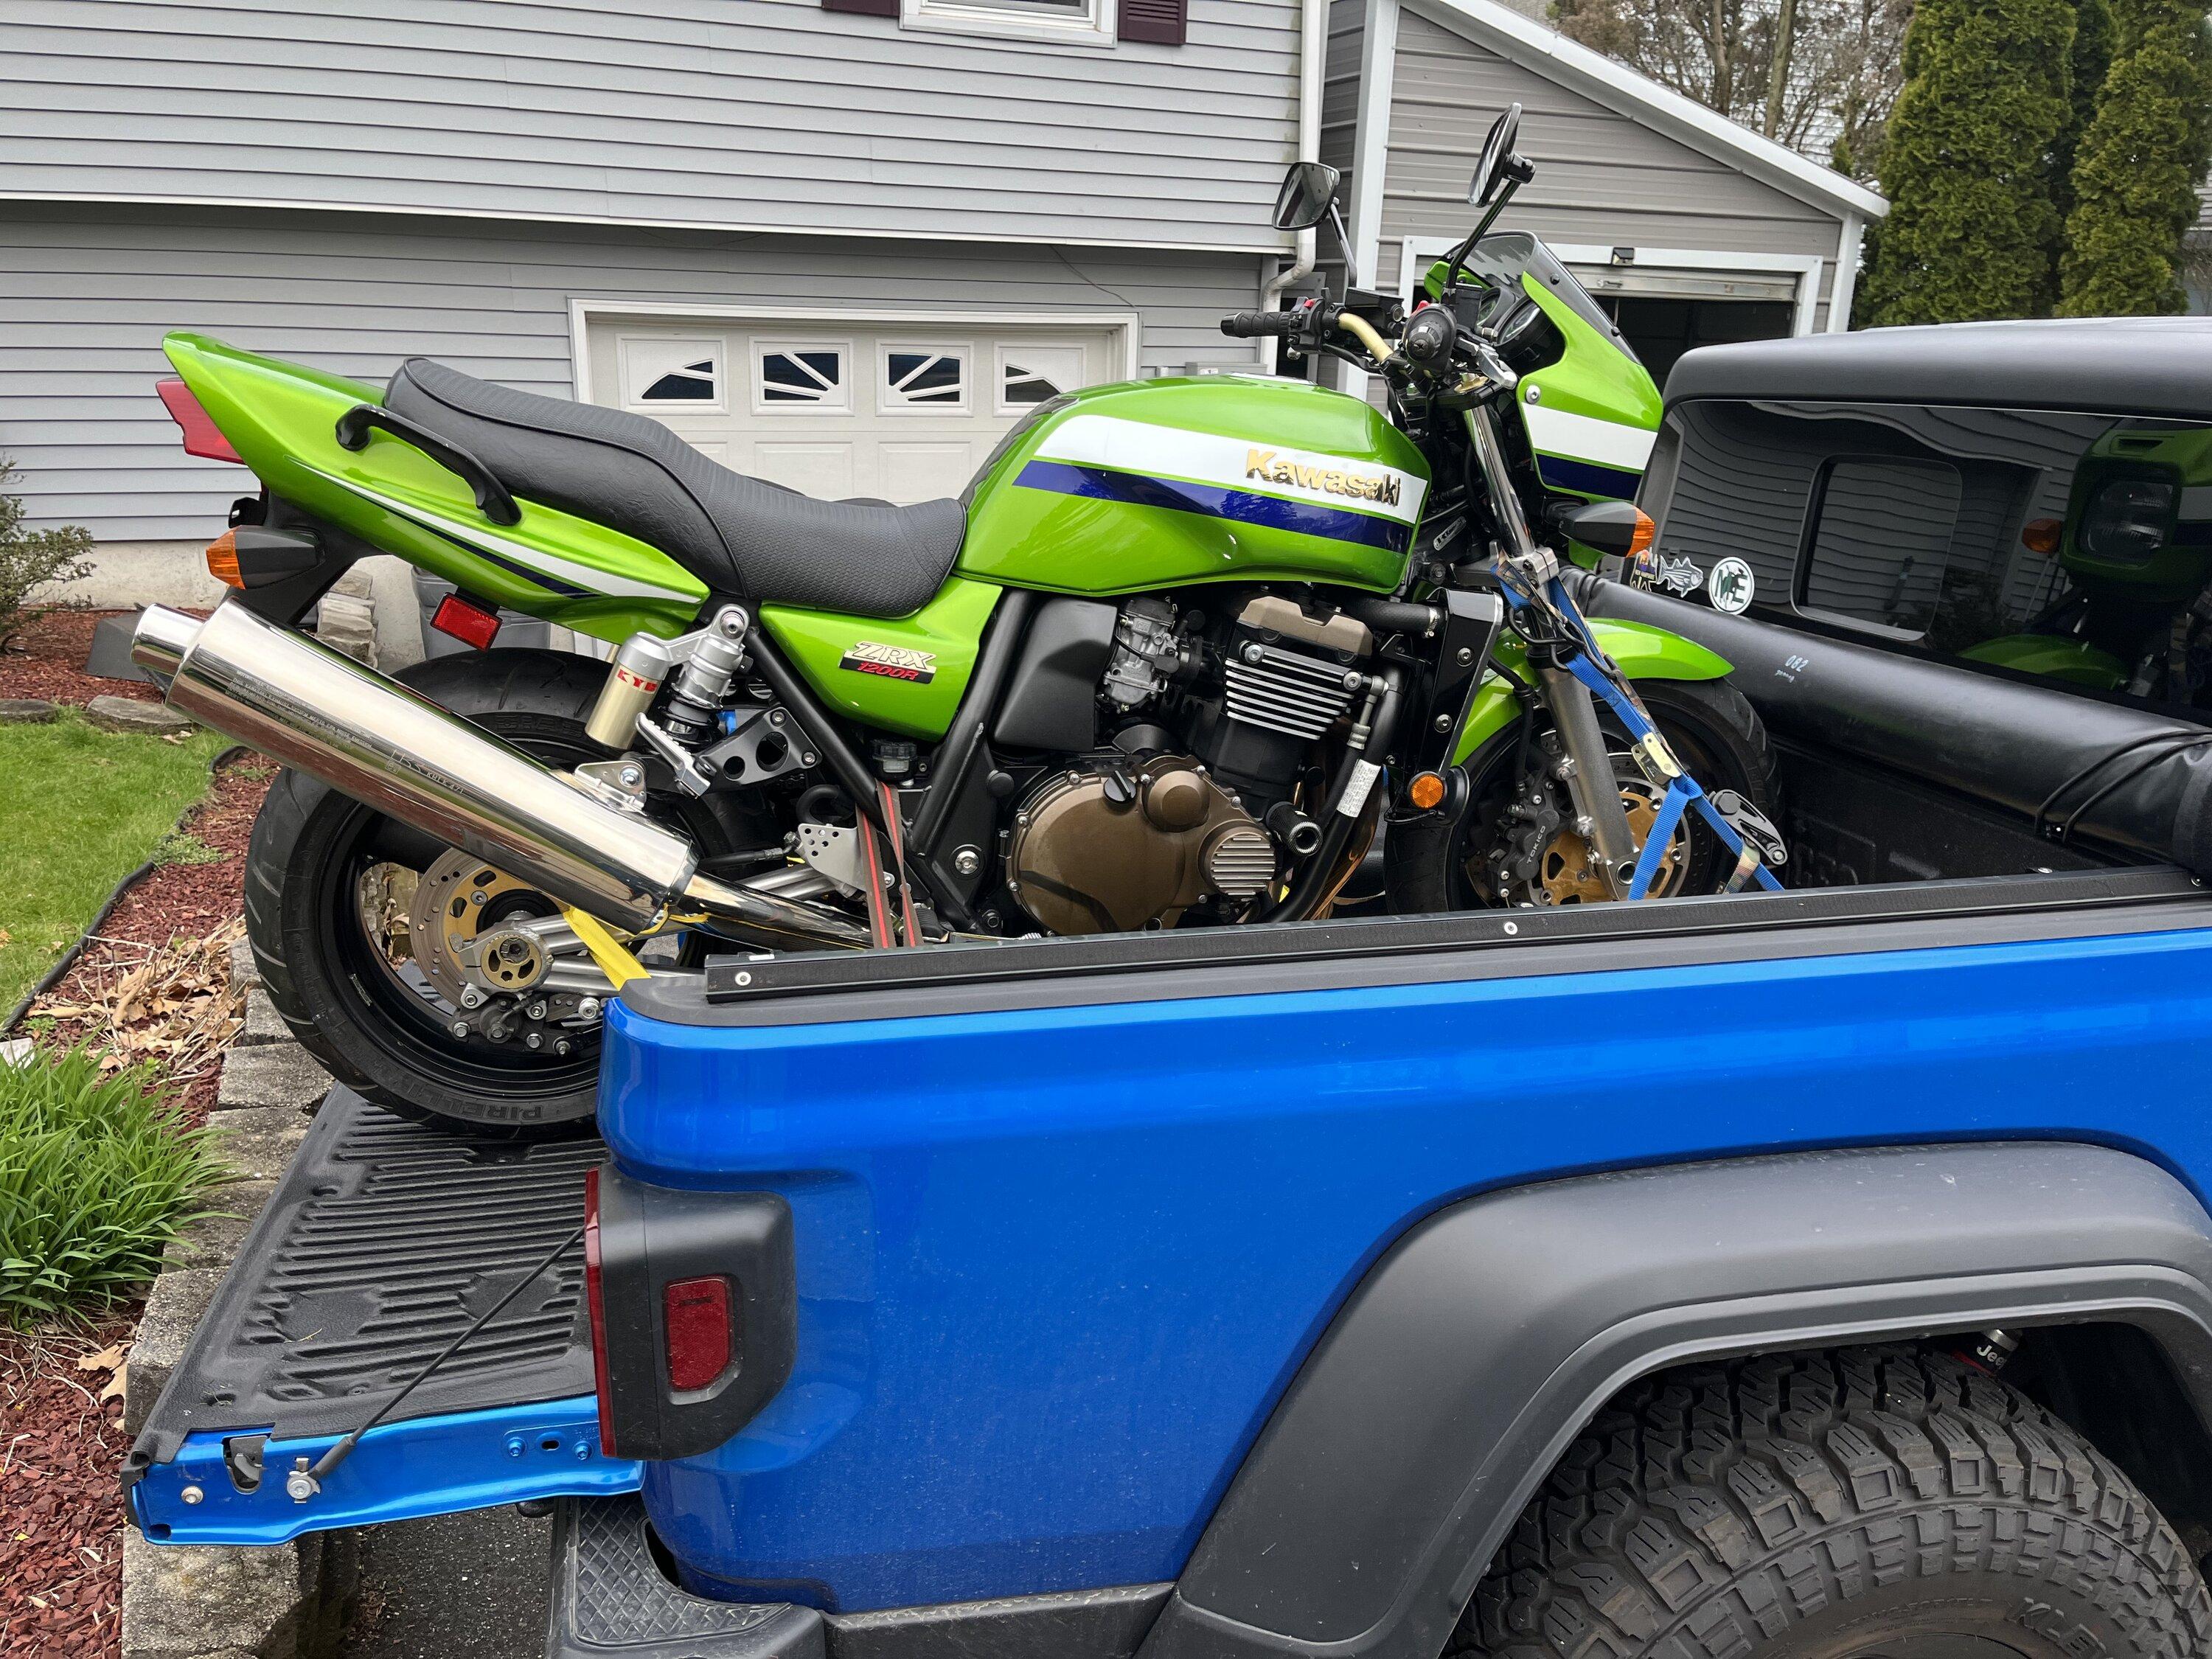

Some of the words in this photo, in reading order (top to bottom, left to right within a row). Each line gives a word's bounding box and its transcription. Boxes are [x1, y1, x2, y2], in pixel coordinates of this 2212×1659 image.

[1245, 449, 1401, 507] Kawasaki
[852, 641, 934, 670] ZRX
[1785, 655, 1809, 672] 082
[617, 669, 658, 692] KYB
[857, 661, 919, 681] 1200R
[1526, 825, 1546, 863] TOKICO
